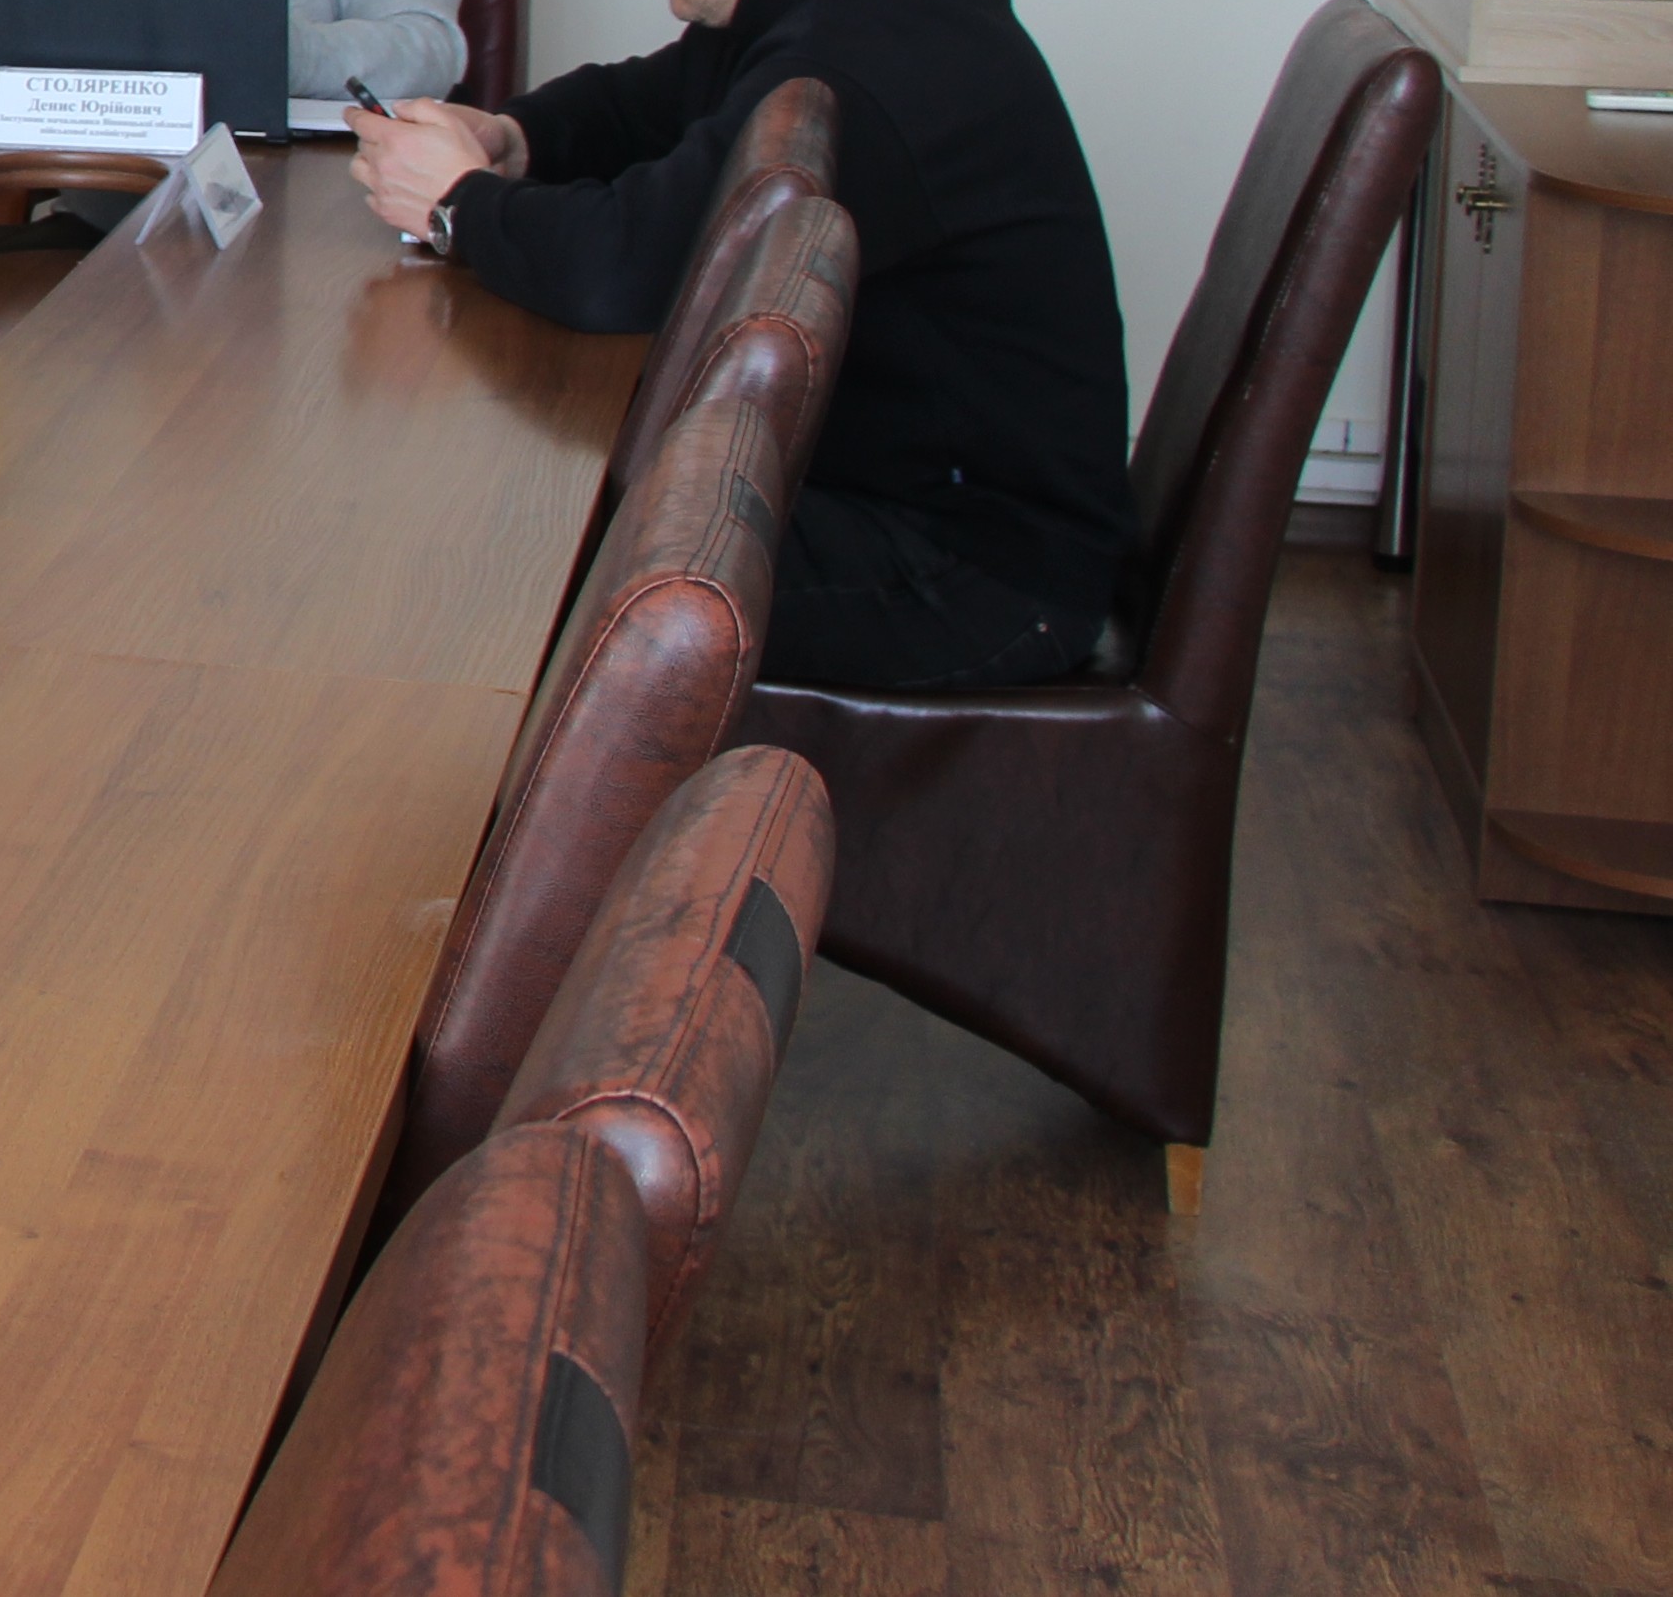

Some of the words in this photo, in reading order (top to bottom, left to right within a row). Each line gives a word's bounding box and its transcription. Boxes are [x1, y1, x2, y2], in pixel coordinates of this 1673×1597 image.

[26, 77, 168, 96] СТОЛЯРЕНКО
[27, 98, 76, 113] Денис
[81, 100, 162, 116] Юрійович
